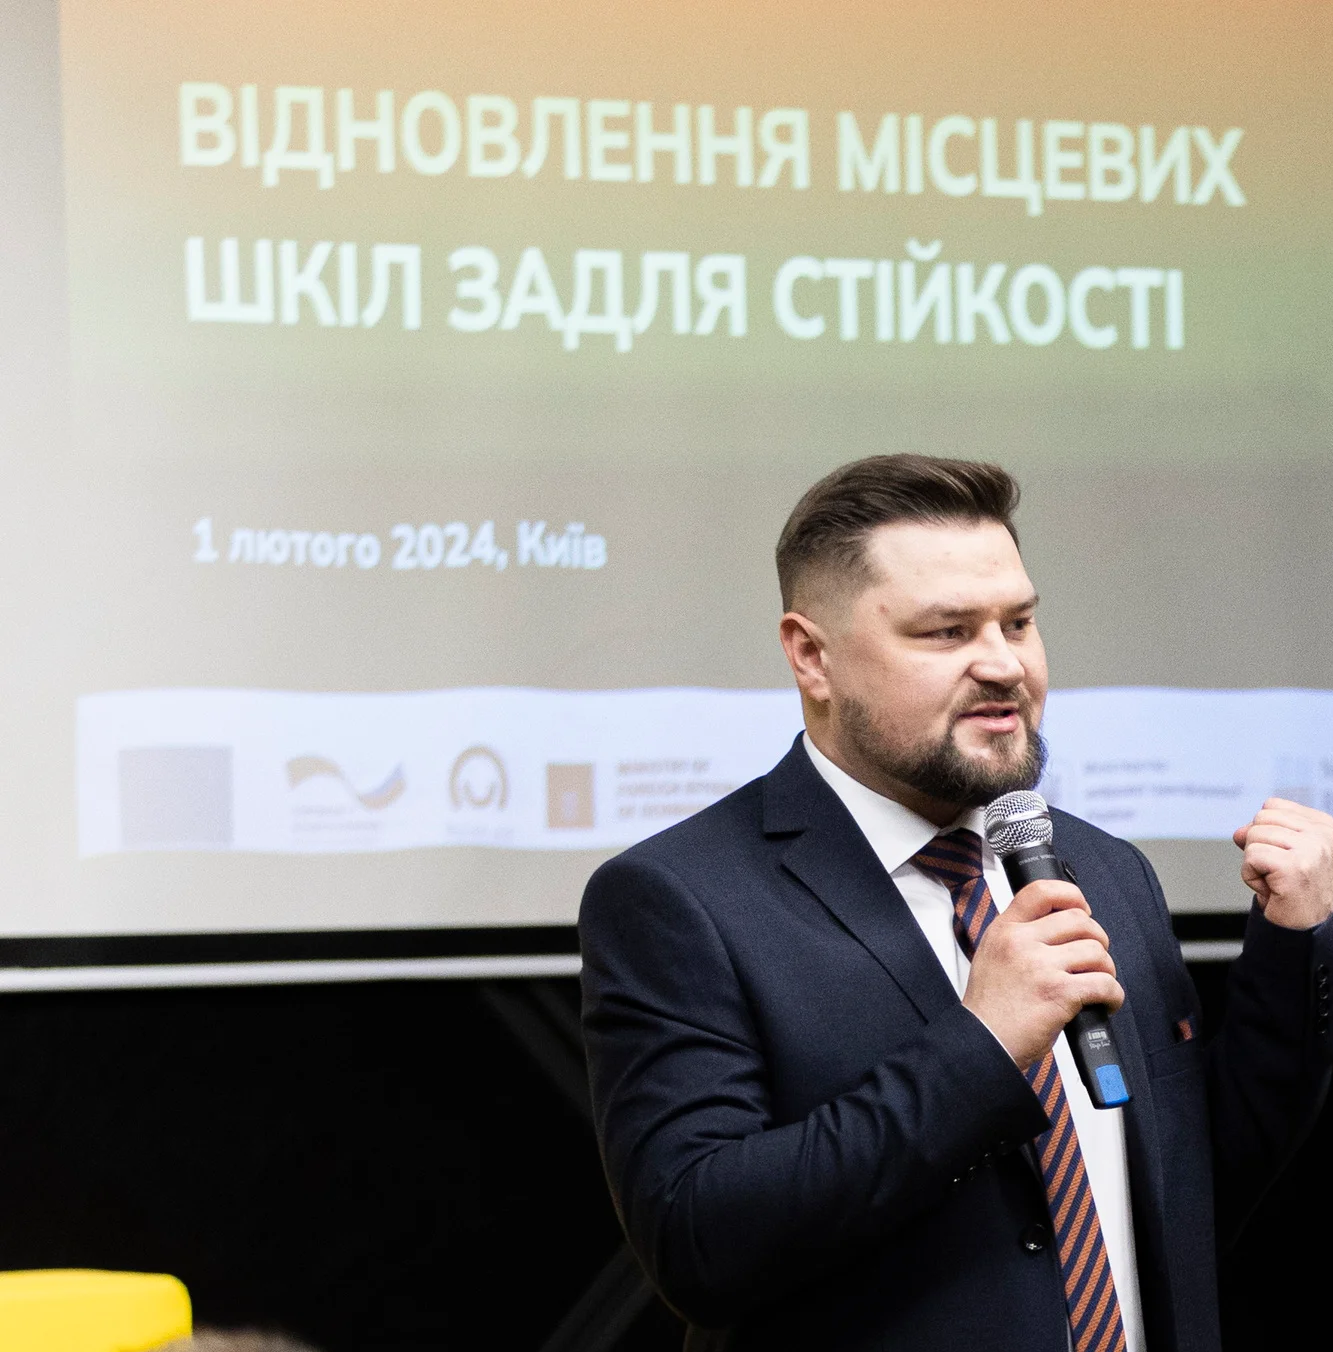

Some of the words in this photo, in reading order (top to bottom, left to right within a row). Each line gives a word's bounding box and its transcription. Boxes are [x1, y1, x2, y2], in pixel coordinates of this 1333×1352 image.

[179, 82, 808, 190] ВІДНОВЛЕННЯ
[838, 112, 1245, 216] МІСЦЕВИХ
[184, 236, 421, 330] ШКІЛ
[448, 246, 747, 352] ЗАДЛЯ
[773, 239, 1184, 349] СТІЙКОСТІ
[193, 517, 219, 563] 1
[227, 528, 381, 569] лютого
[391, 520, 508, 571] 2024,
[517, 520, 608, 569] Київ
